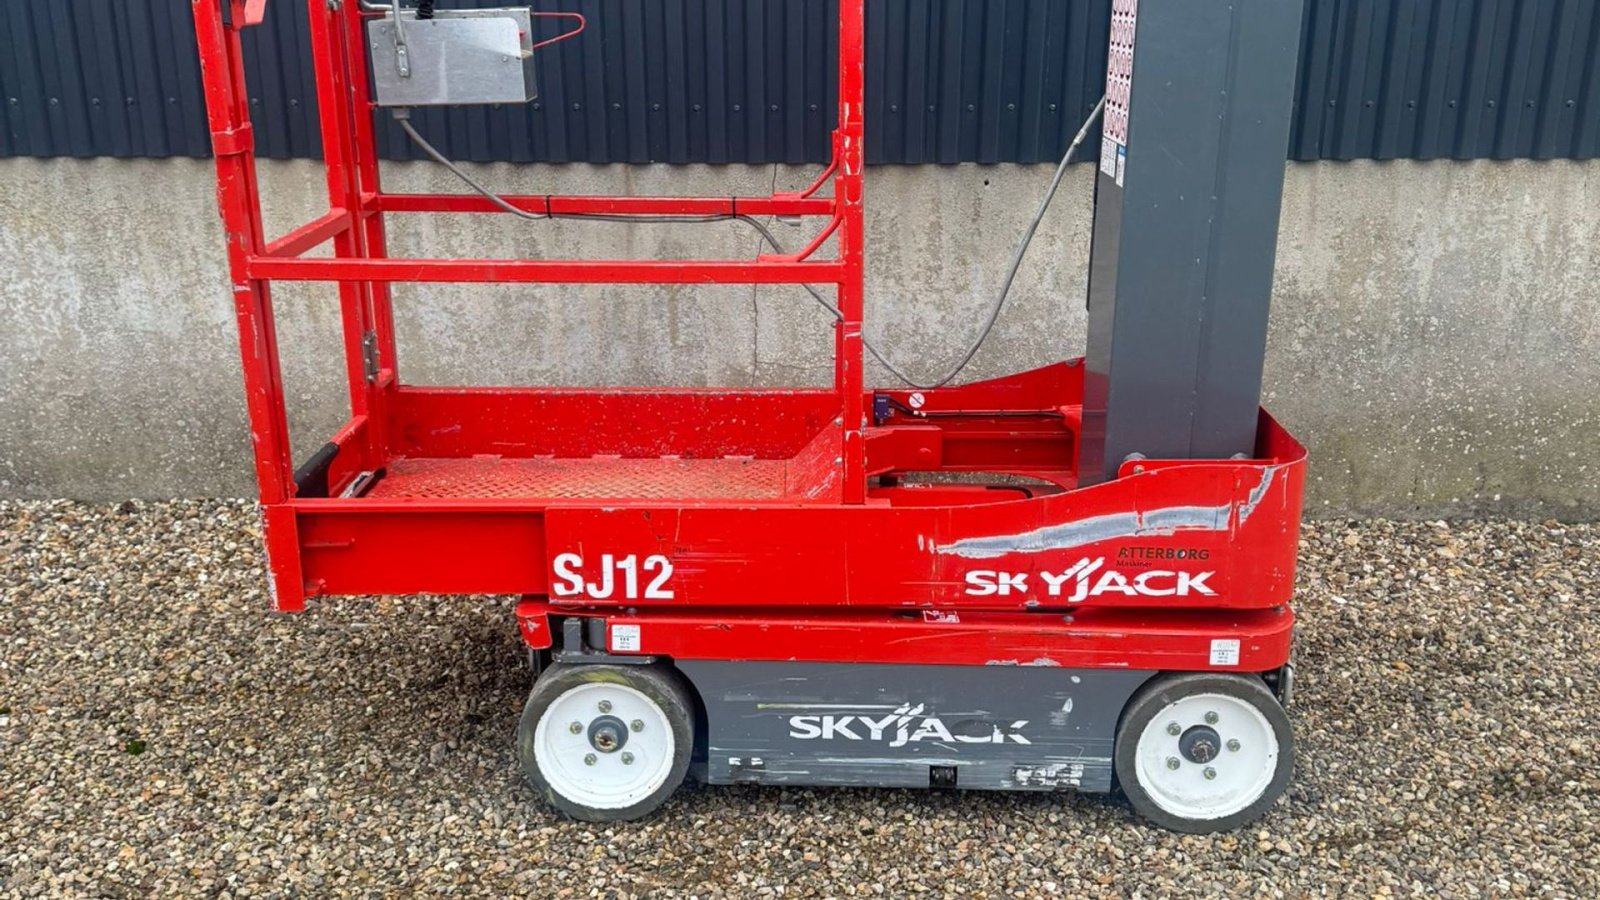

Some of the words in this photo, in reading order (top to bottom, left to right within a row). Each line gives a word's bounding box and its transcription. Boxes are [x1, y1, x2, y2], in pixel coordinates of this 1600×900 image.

[553, 552, 675, 599] SJ12
[1118, 547, 1210, 560] ATTERBORG
[965, 556, 1219, 602] SKYJACK
